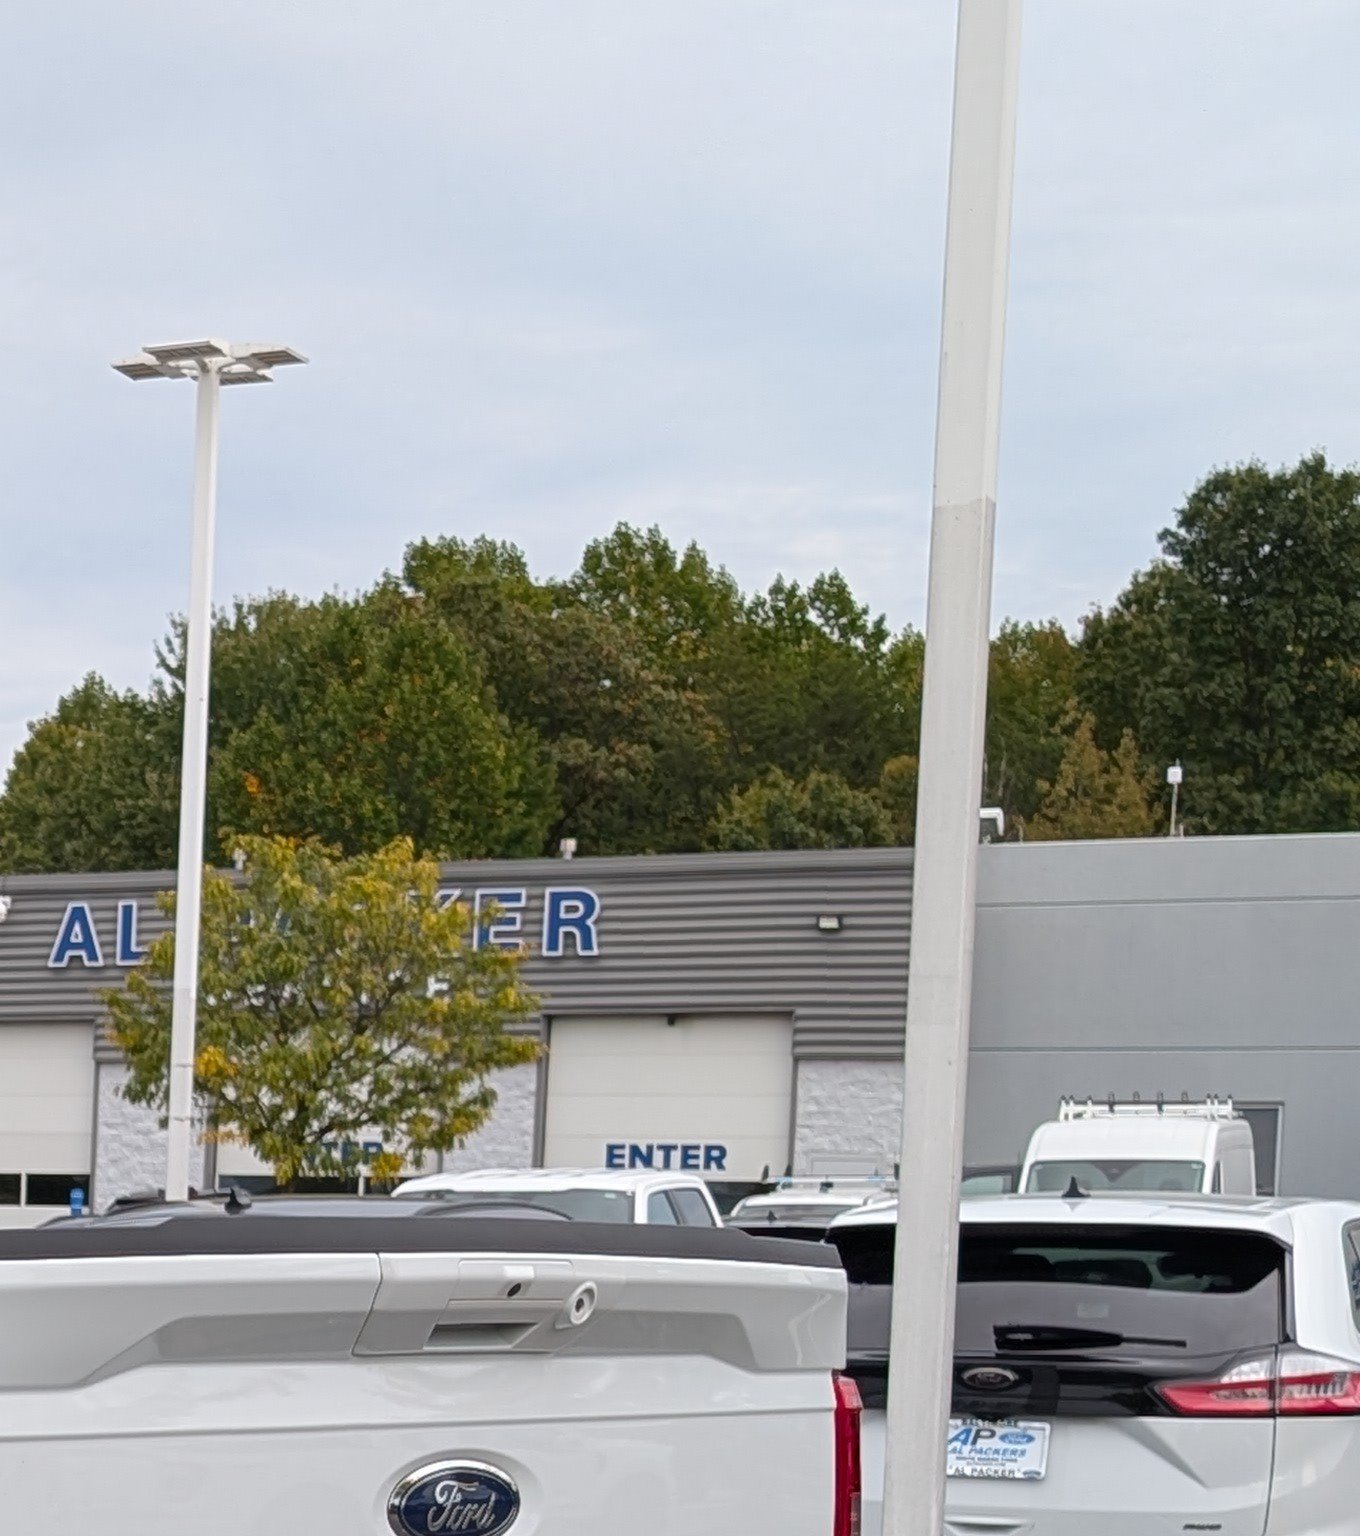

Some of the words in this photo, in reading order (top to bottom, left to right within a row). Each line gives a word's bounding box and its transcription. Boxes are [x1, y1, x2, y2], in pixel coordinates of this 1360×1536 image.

[48, 900, 149, 968] AL
[605, 1143, 728, 1171] ENTER
[426, 1479, 497, 1532] Ford
